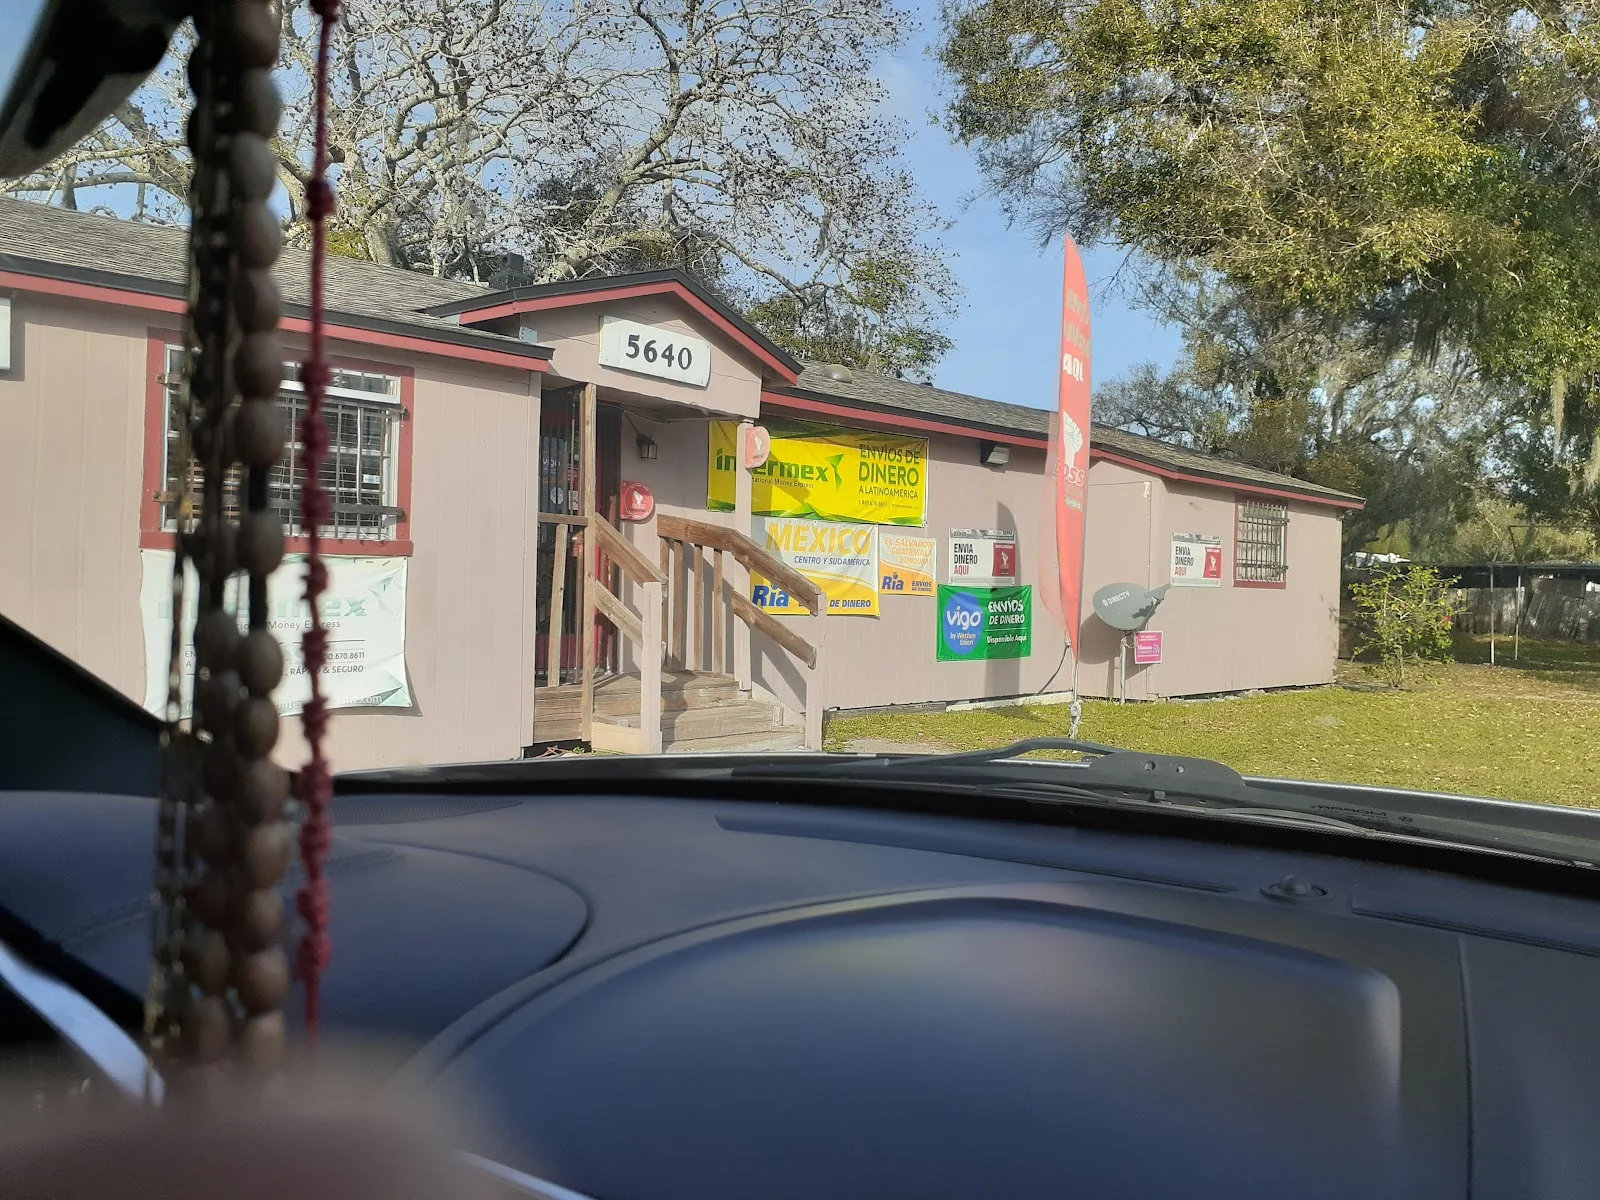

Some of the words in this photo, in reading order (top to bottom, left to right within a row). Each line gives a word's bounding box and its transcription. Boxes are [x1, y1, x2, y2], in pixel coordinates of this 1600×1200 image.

[626, 334, 693, 371] 5640
[860, 443, 902, 463] ENVÍOS
[905, 450, 920, 465] DE
[716, 447, 829, 482] inermex
[859, 461, 920, 487] DINERO
[774, 478, 793, 488] Money
[793, 480, 814, 489] Express
[859, 485, 865, 494] A
[865, 486, 919, 500] LATINOAMERICA
[765, 522, 872, 556] MEXICO
[884, 537, 894, 546] EL
[794, 555, 821, 565] CENTRO
[823, 556, 829, 565] Y
[829, 557, 871, 567] SUDAMERICA
[953, 554, 978, 565] DINERO
[1175, 556, 1195, 567] DINERO
[882, 572, 904, 591] Ria
[752, 584, 790, 608] Ria
[1107, 590, 1131, 605] DIRECTV
[829, 599, 840, 608] DE
[841, 599, 872, 608] DINERO
[946, 605, 982, 631] vigo
[989, 615, 999, 625] DE
[999, 613, 1025, 625] DINERO
[268, 621, 301, 631] Money
[950, 632, 956, 641] by
[957, 632, 977, 640] Western
[331, 665, 364, 674] SEGURO
